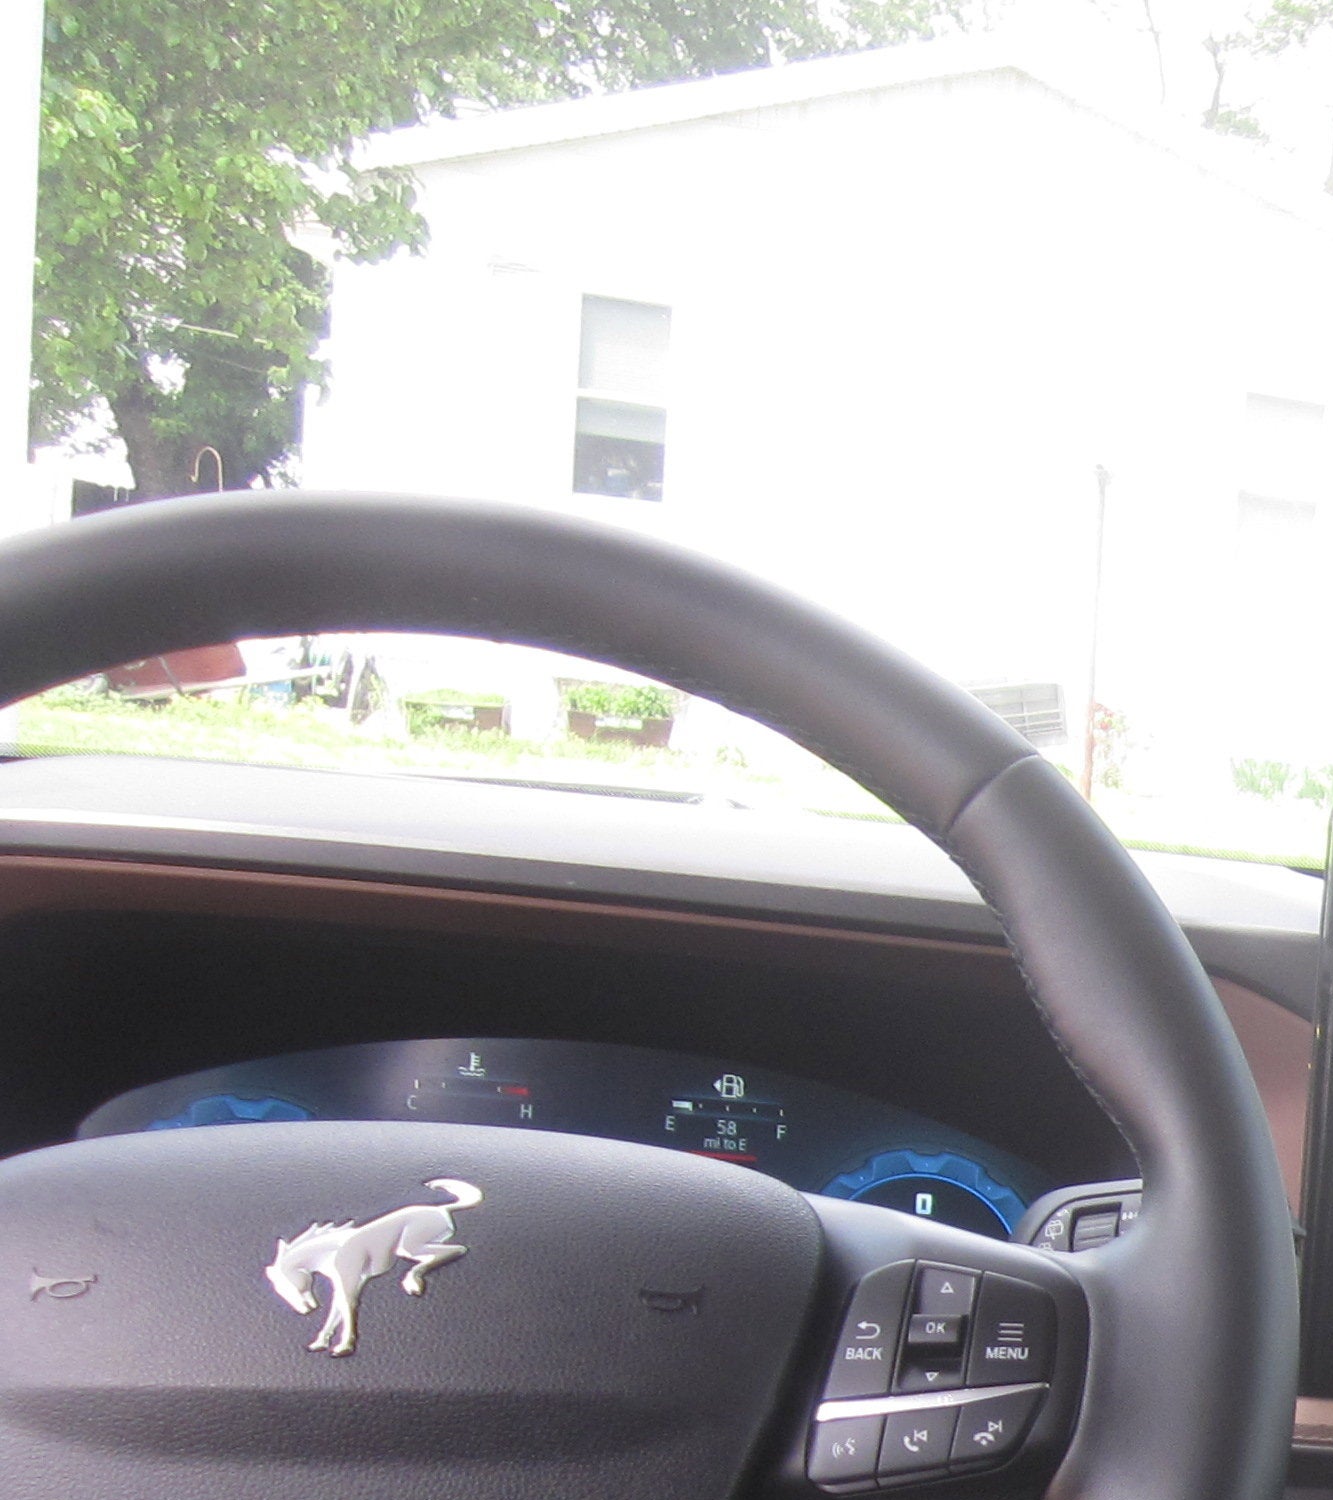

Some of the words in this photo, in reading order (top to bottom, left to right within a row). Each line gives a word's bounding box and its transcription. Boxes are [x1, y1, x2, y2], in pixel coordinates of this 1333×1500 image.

[406, 1095, 418, 1110] C
[519, 1103, 533, 1119] H
[664, 1115, 676, 1131] E
[716, 1119, 737, 1135] 58
[776, 1124, 787, 1139] F
[738, 1138, 748, 1151] E
[915, 1192, 932, 1215] 0
[925, 1321, 946, 1334] OK
[844, 1347, 882, 1361] BACK
[985, 1347, 1029, 1360] MENU
